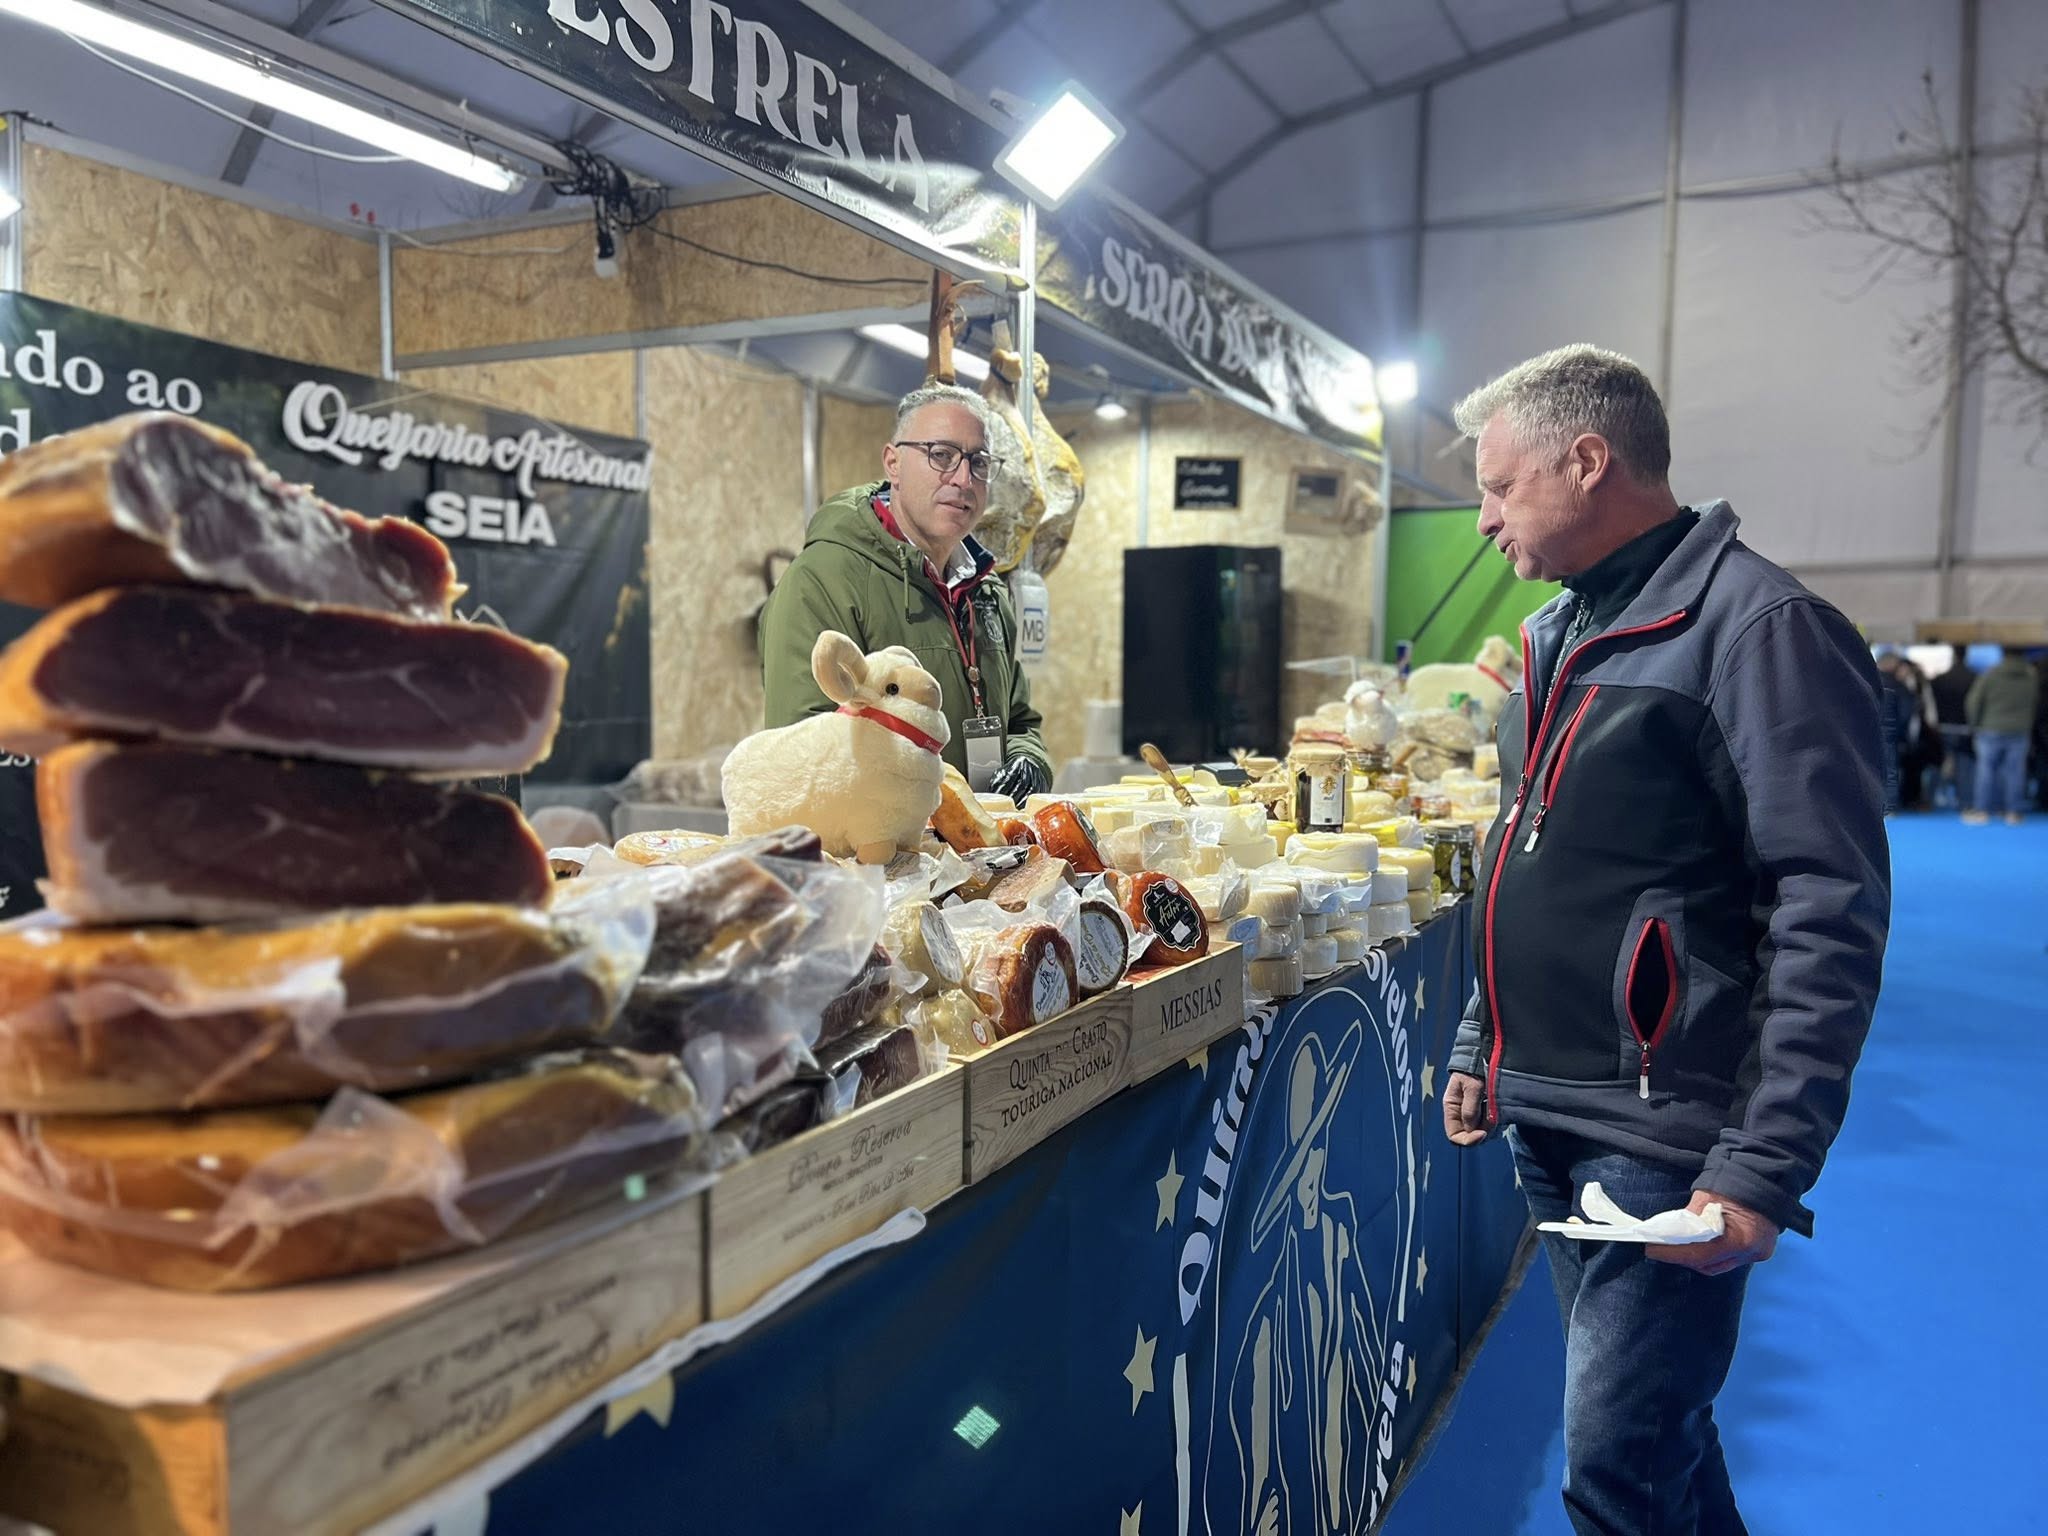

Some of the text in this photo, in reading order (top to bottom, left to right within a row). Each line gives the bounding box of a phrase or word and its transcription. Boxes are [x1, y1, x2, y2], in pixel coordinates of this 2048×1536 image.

[1101, 236, 1214, 360] SERRA
[126, 369, 203, 415] ao
[493, 428, 653, 498] Artesanal
[425, 491, 556, 547] SEIA
[1022, 619, 1045, 642] MB
[1161, 979, 1222, 1035] MESSIAS
[1360, 948, 1413, 1115] ovelos
[1001, 1050, 1113, 1128] TOURIGA NACIONAL
[1362, 1340, 1405, 1536] trela
